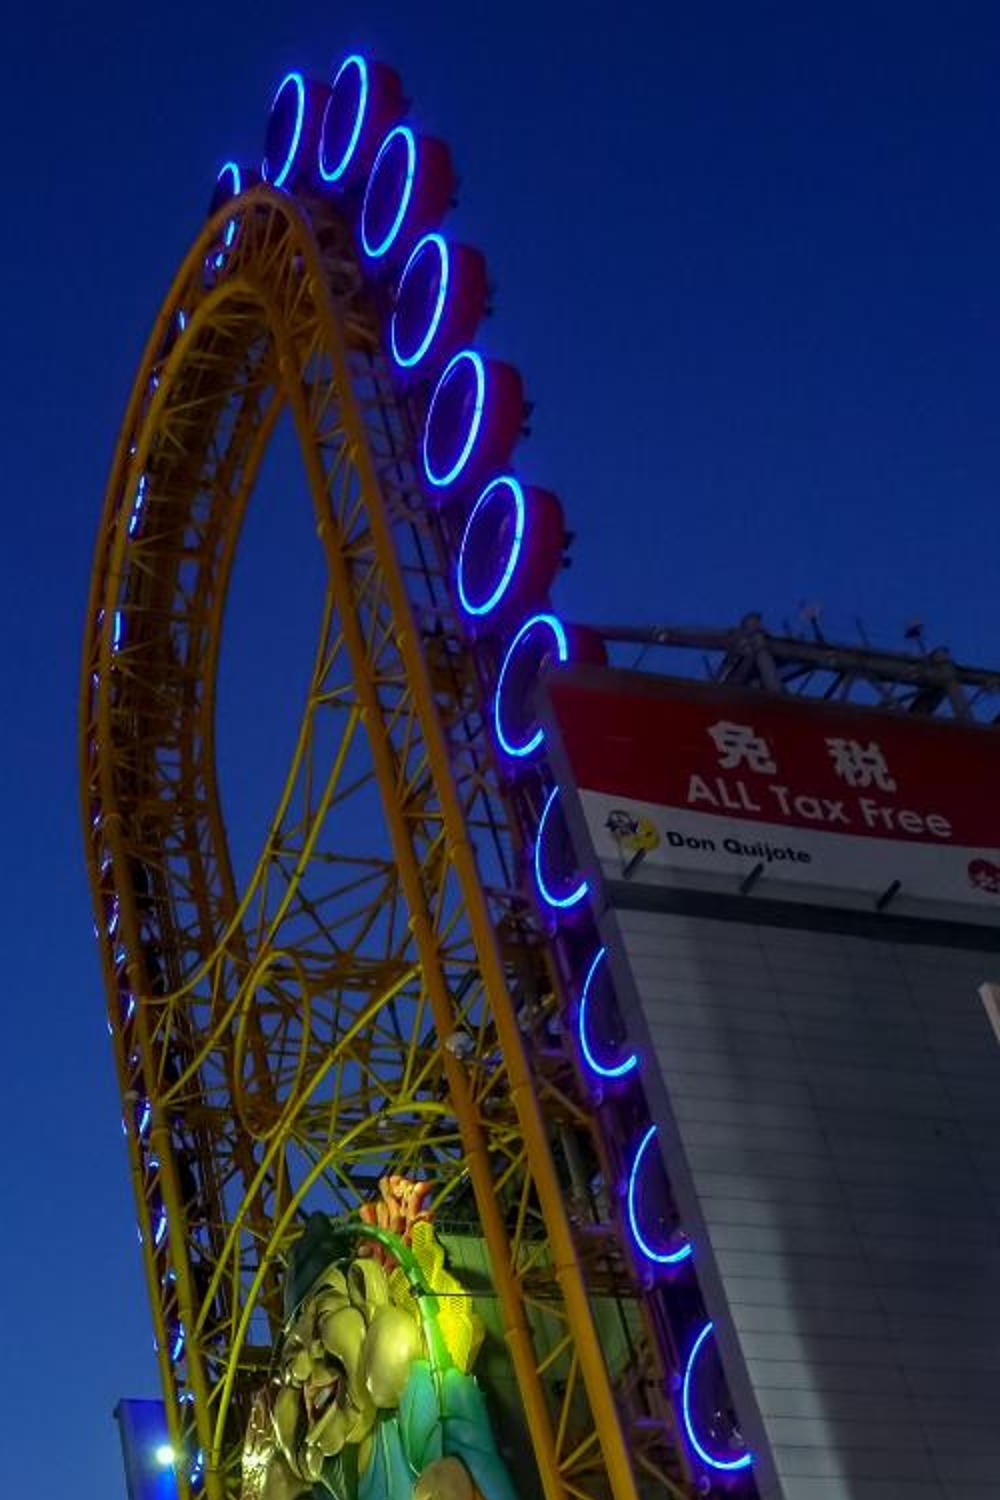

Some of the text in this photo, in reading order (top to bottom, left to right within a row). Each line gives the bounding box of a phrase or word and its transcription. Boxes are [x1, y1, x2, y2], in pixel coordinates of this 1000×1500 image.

[707, 720, 898, 793] 免税
[687, 774, 954, 838] ALL Tax Free
[666, 829, 812, 865] Don Quijote
